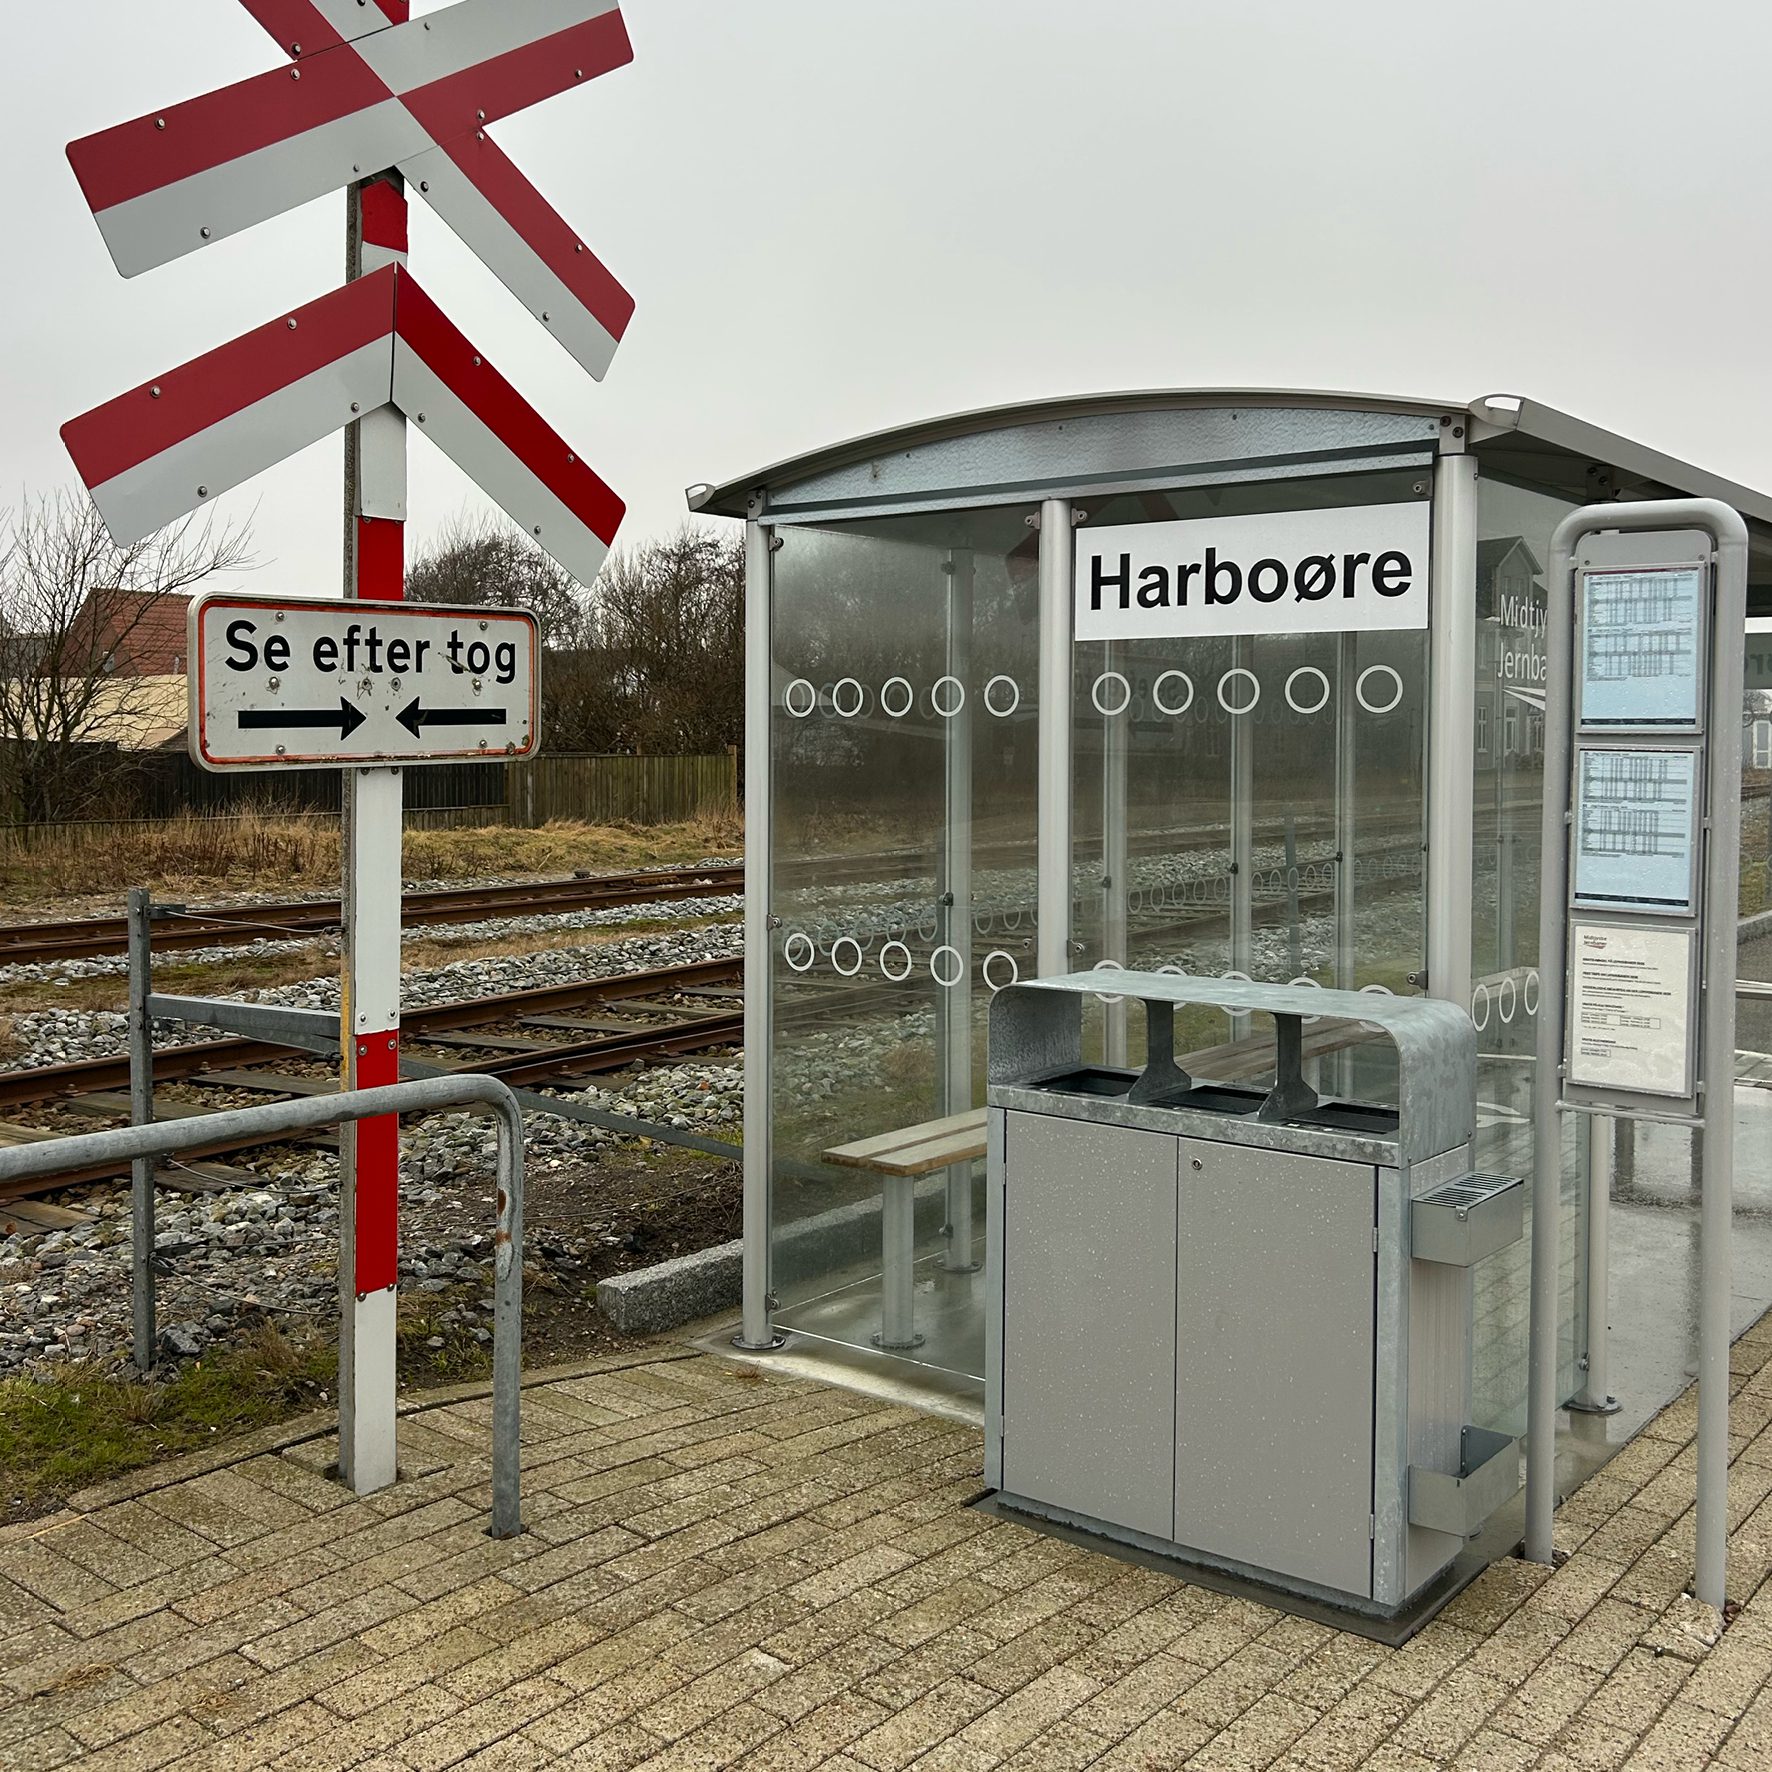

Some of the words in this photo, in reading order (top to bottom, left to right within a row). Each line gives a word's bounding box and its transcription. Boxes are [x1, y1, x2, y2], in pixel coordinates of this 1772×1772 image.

[1090, 547, 1412, 610] Harboøre
[1500, 594, 1548, 638] Midtjy
[225, 619, 290, 672] Se
[313, 624, 430, 674] efter
[447, 630, 516, 684] tog
[1498, 642, 1547, 681] Jernba
